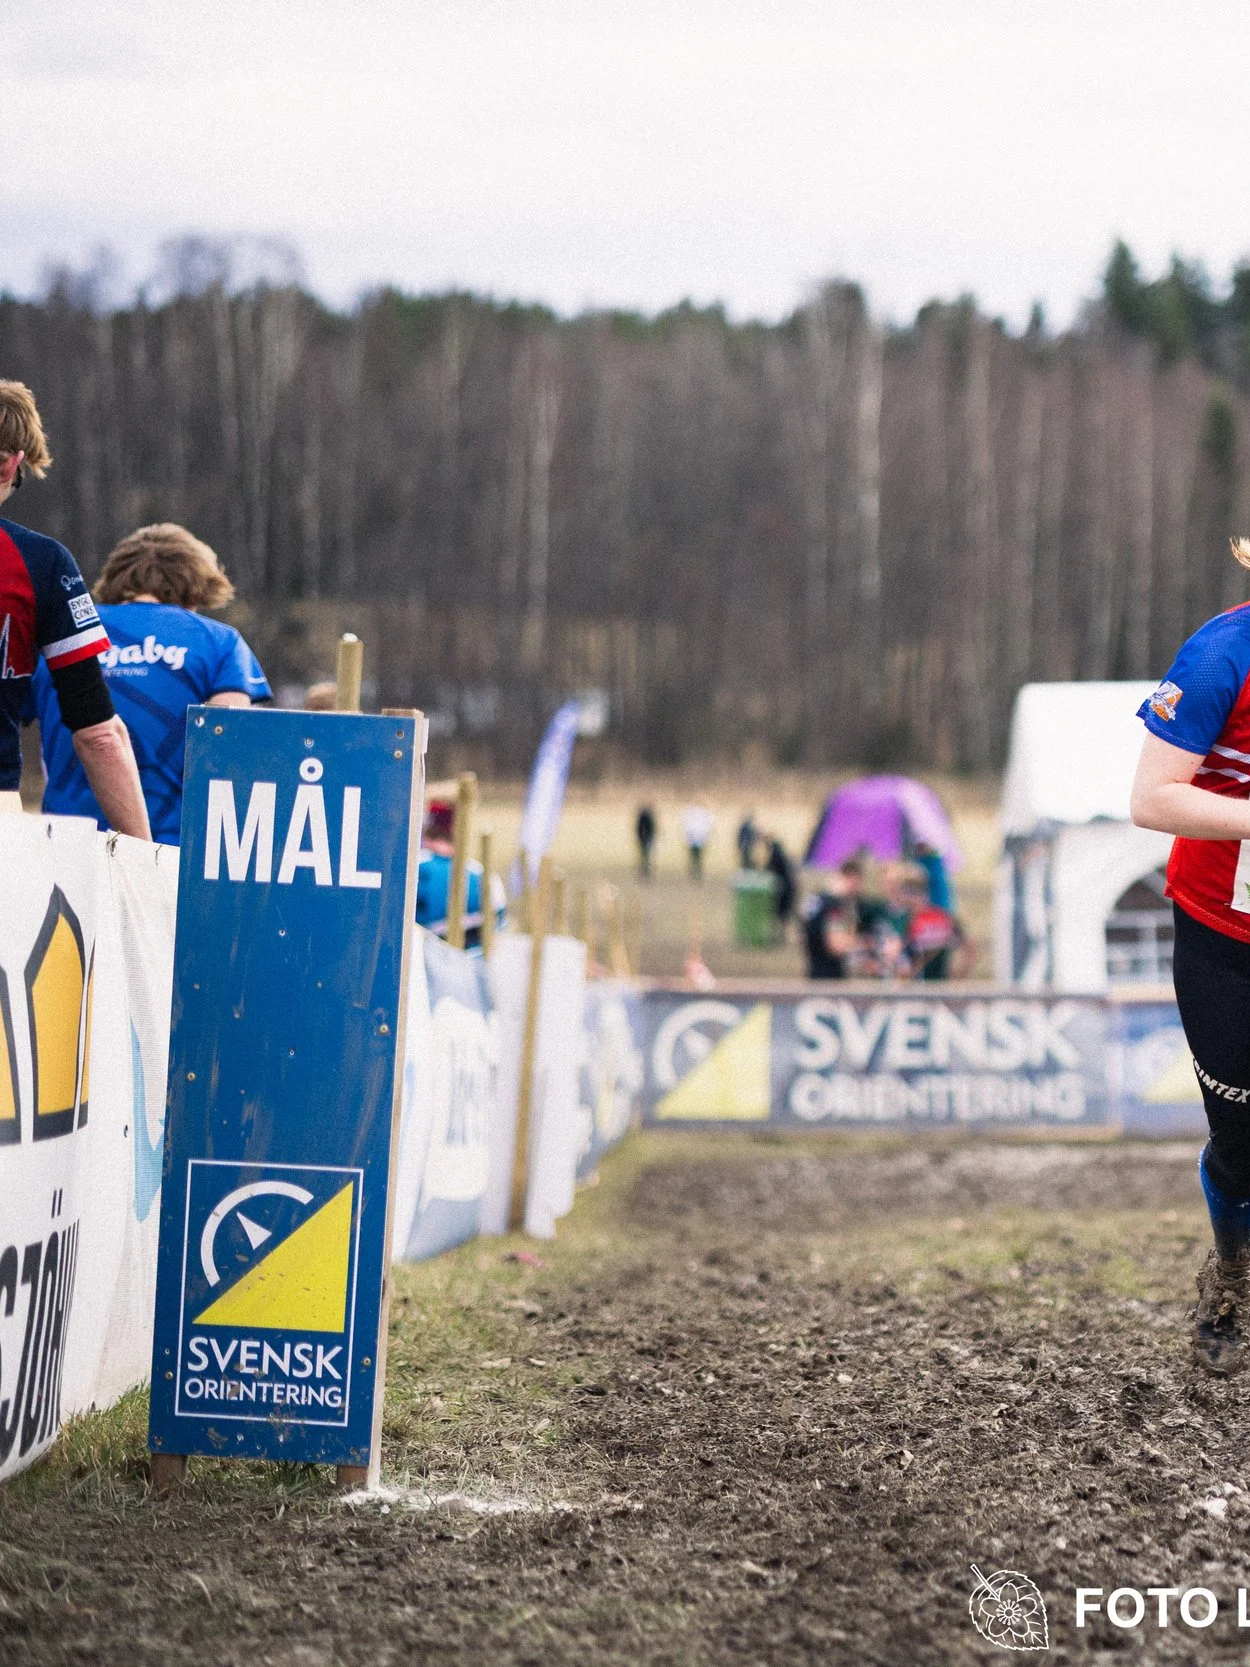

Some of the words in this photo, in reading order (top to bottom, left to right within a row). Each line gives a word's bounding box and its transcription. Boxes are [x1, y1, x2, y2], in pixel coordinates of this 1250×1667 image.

[204, 757, 382, 888] MÅL
[796, 998, 1080, 1070] SVENSK
[792, 1071, 1086, 1120] ORIENTERING
[187, 1336, 343, 1380] SVENSK
[185, 1377, 342, 1408] ORIENTERING
